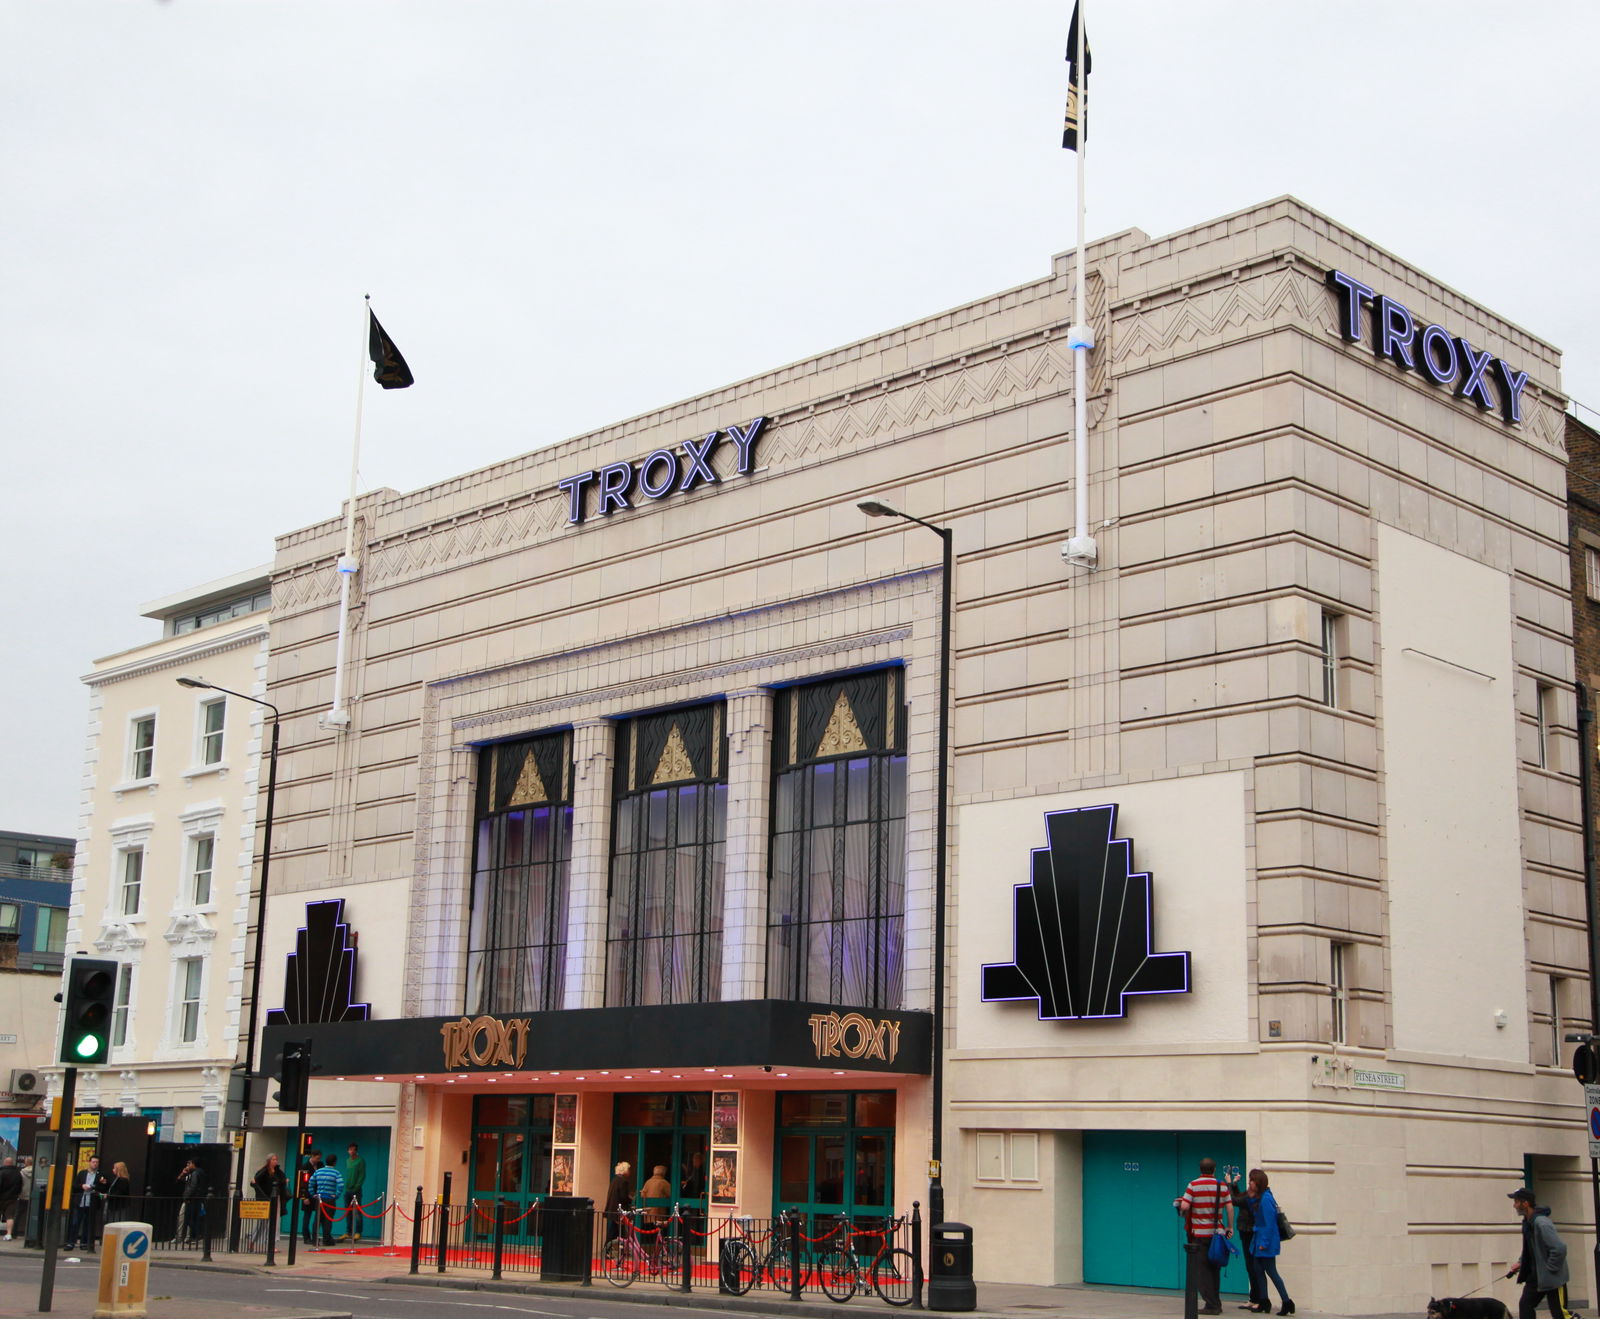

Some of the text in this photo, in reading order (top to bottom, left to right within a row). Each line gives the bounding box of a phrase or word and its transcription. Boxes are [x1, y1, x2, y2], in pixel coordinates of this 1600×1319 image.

[1326, 269, 1529, 424] TROXY
[559, 416, 768, 525] TROXY
[440, 1015, 531, 1071] TROXY
[808, 1011, 901, 1064] TROXY
[1355, 1072, 1398, 1084] PITSEA STREET
[73, 1118, 98, 1126] STRETTONS
